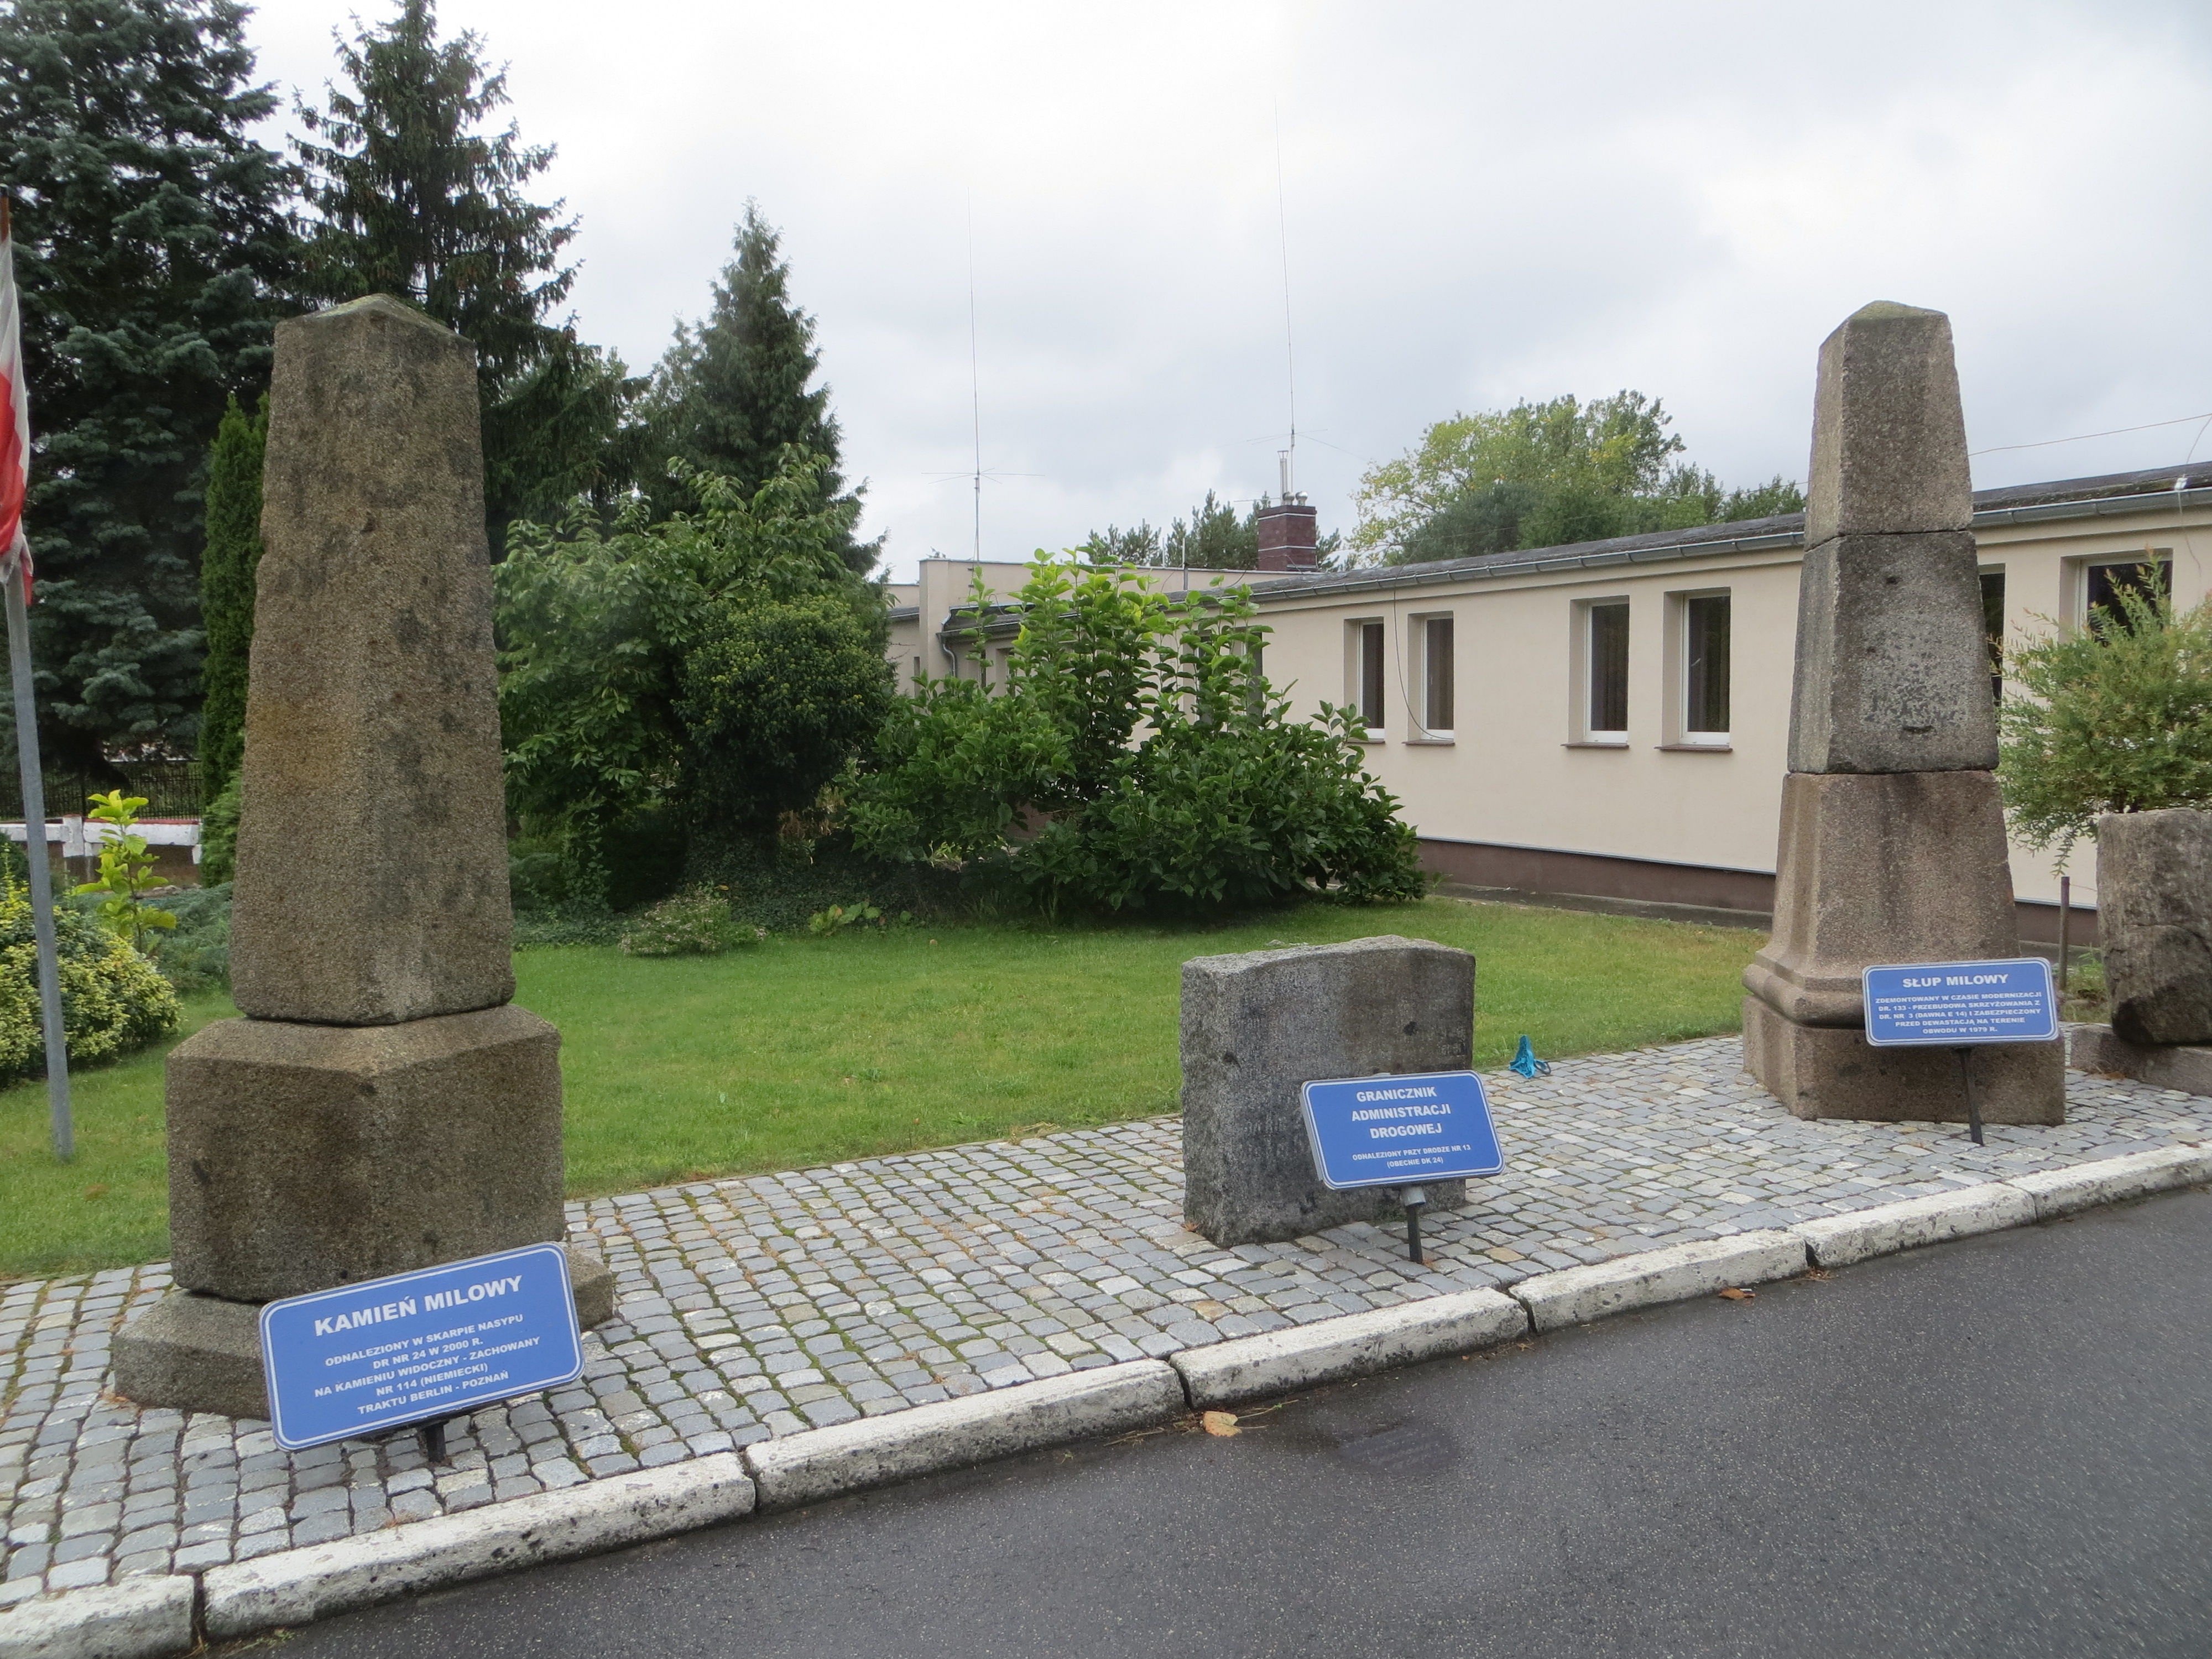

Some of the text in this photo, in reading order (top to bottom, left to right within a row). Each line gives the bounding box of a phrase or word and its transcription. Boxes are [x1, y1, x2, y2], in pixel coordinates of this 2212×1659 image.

[1902, 974, 2008, 988] SŁUP MILOWY
[1357, 1087, 1437, 1102] GRANICZNIK
[1352, 1104, 1451, 1121] ADMINISTRACJI
[1370, 1123, 1442, 1139] DROGOWEJ
[1352, 1150, 1401, 1161] ODNALEZIONY
[1423, 1146, 1449, 1154] DRODZE
[1387, 1159, 1418, 1168] (OBECNIE
[315, 1275, 522, 1336] KAMIEŃ MILOWY
[325, 1314, 523, 1366] ODNALEZIONY W SKARPIE NASYPU
[373, 1337, 483, 1369] DR NR 24 W 2000 R.
[315, 1387, 332, 1397] NA
[335, 1371, 395, 1392] KAMIENIU
[398, 1357, 460, 1379] WIDOCZNY
[470, 1337, 540, 1359] ZACHOWANY
[376, 1363, 488, 1396] NR 114 (NIEMIECKI)
[358, 1396, 407, 1415] TRAKTU
[410, 1385, 452, 1403] BERLIN
[462, 1370, 509, 1389] POZNAŃ
